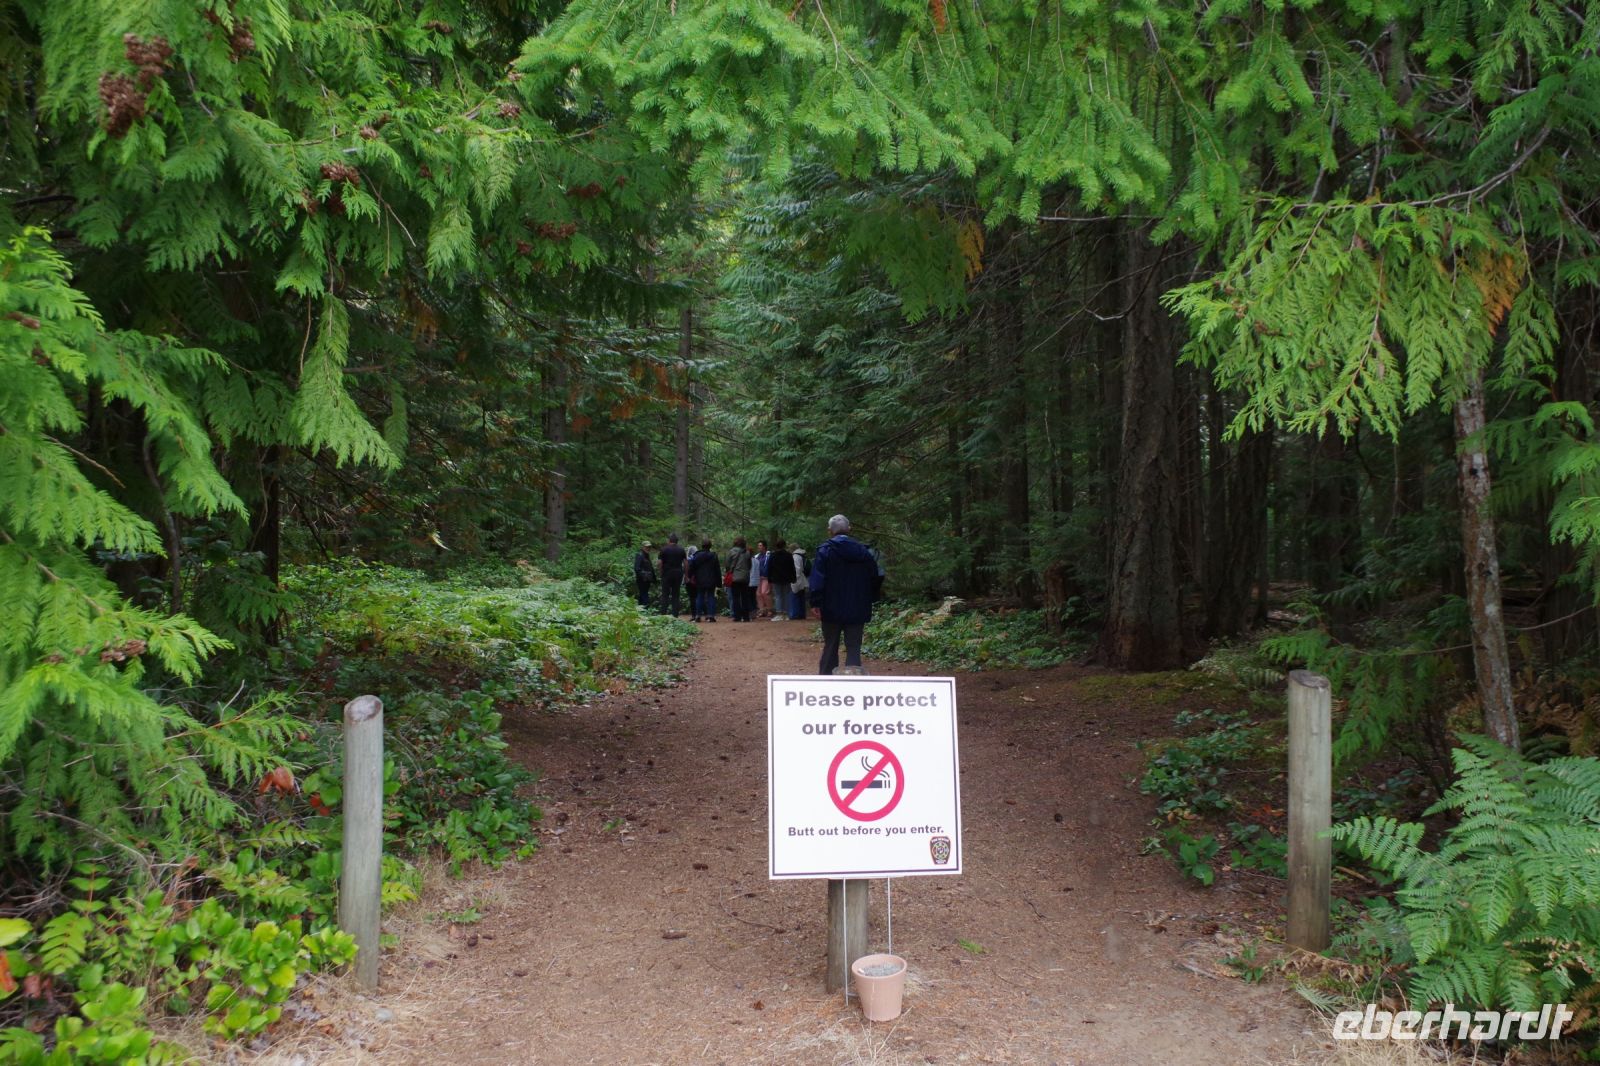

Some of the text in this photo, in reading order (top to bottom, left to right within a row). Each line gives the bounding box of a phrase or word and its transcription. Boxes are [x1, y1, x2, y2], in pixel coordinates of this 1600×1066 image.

[785, 691, 937, 710] Please protect
[802, 720, 922, 735] our forests.
[788, 824, 944, 837] Butt out before you enter.
